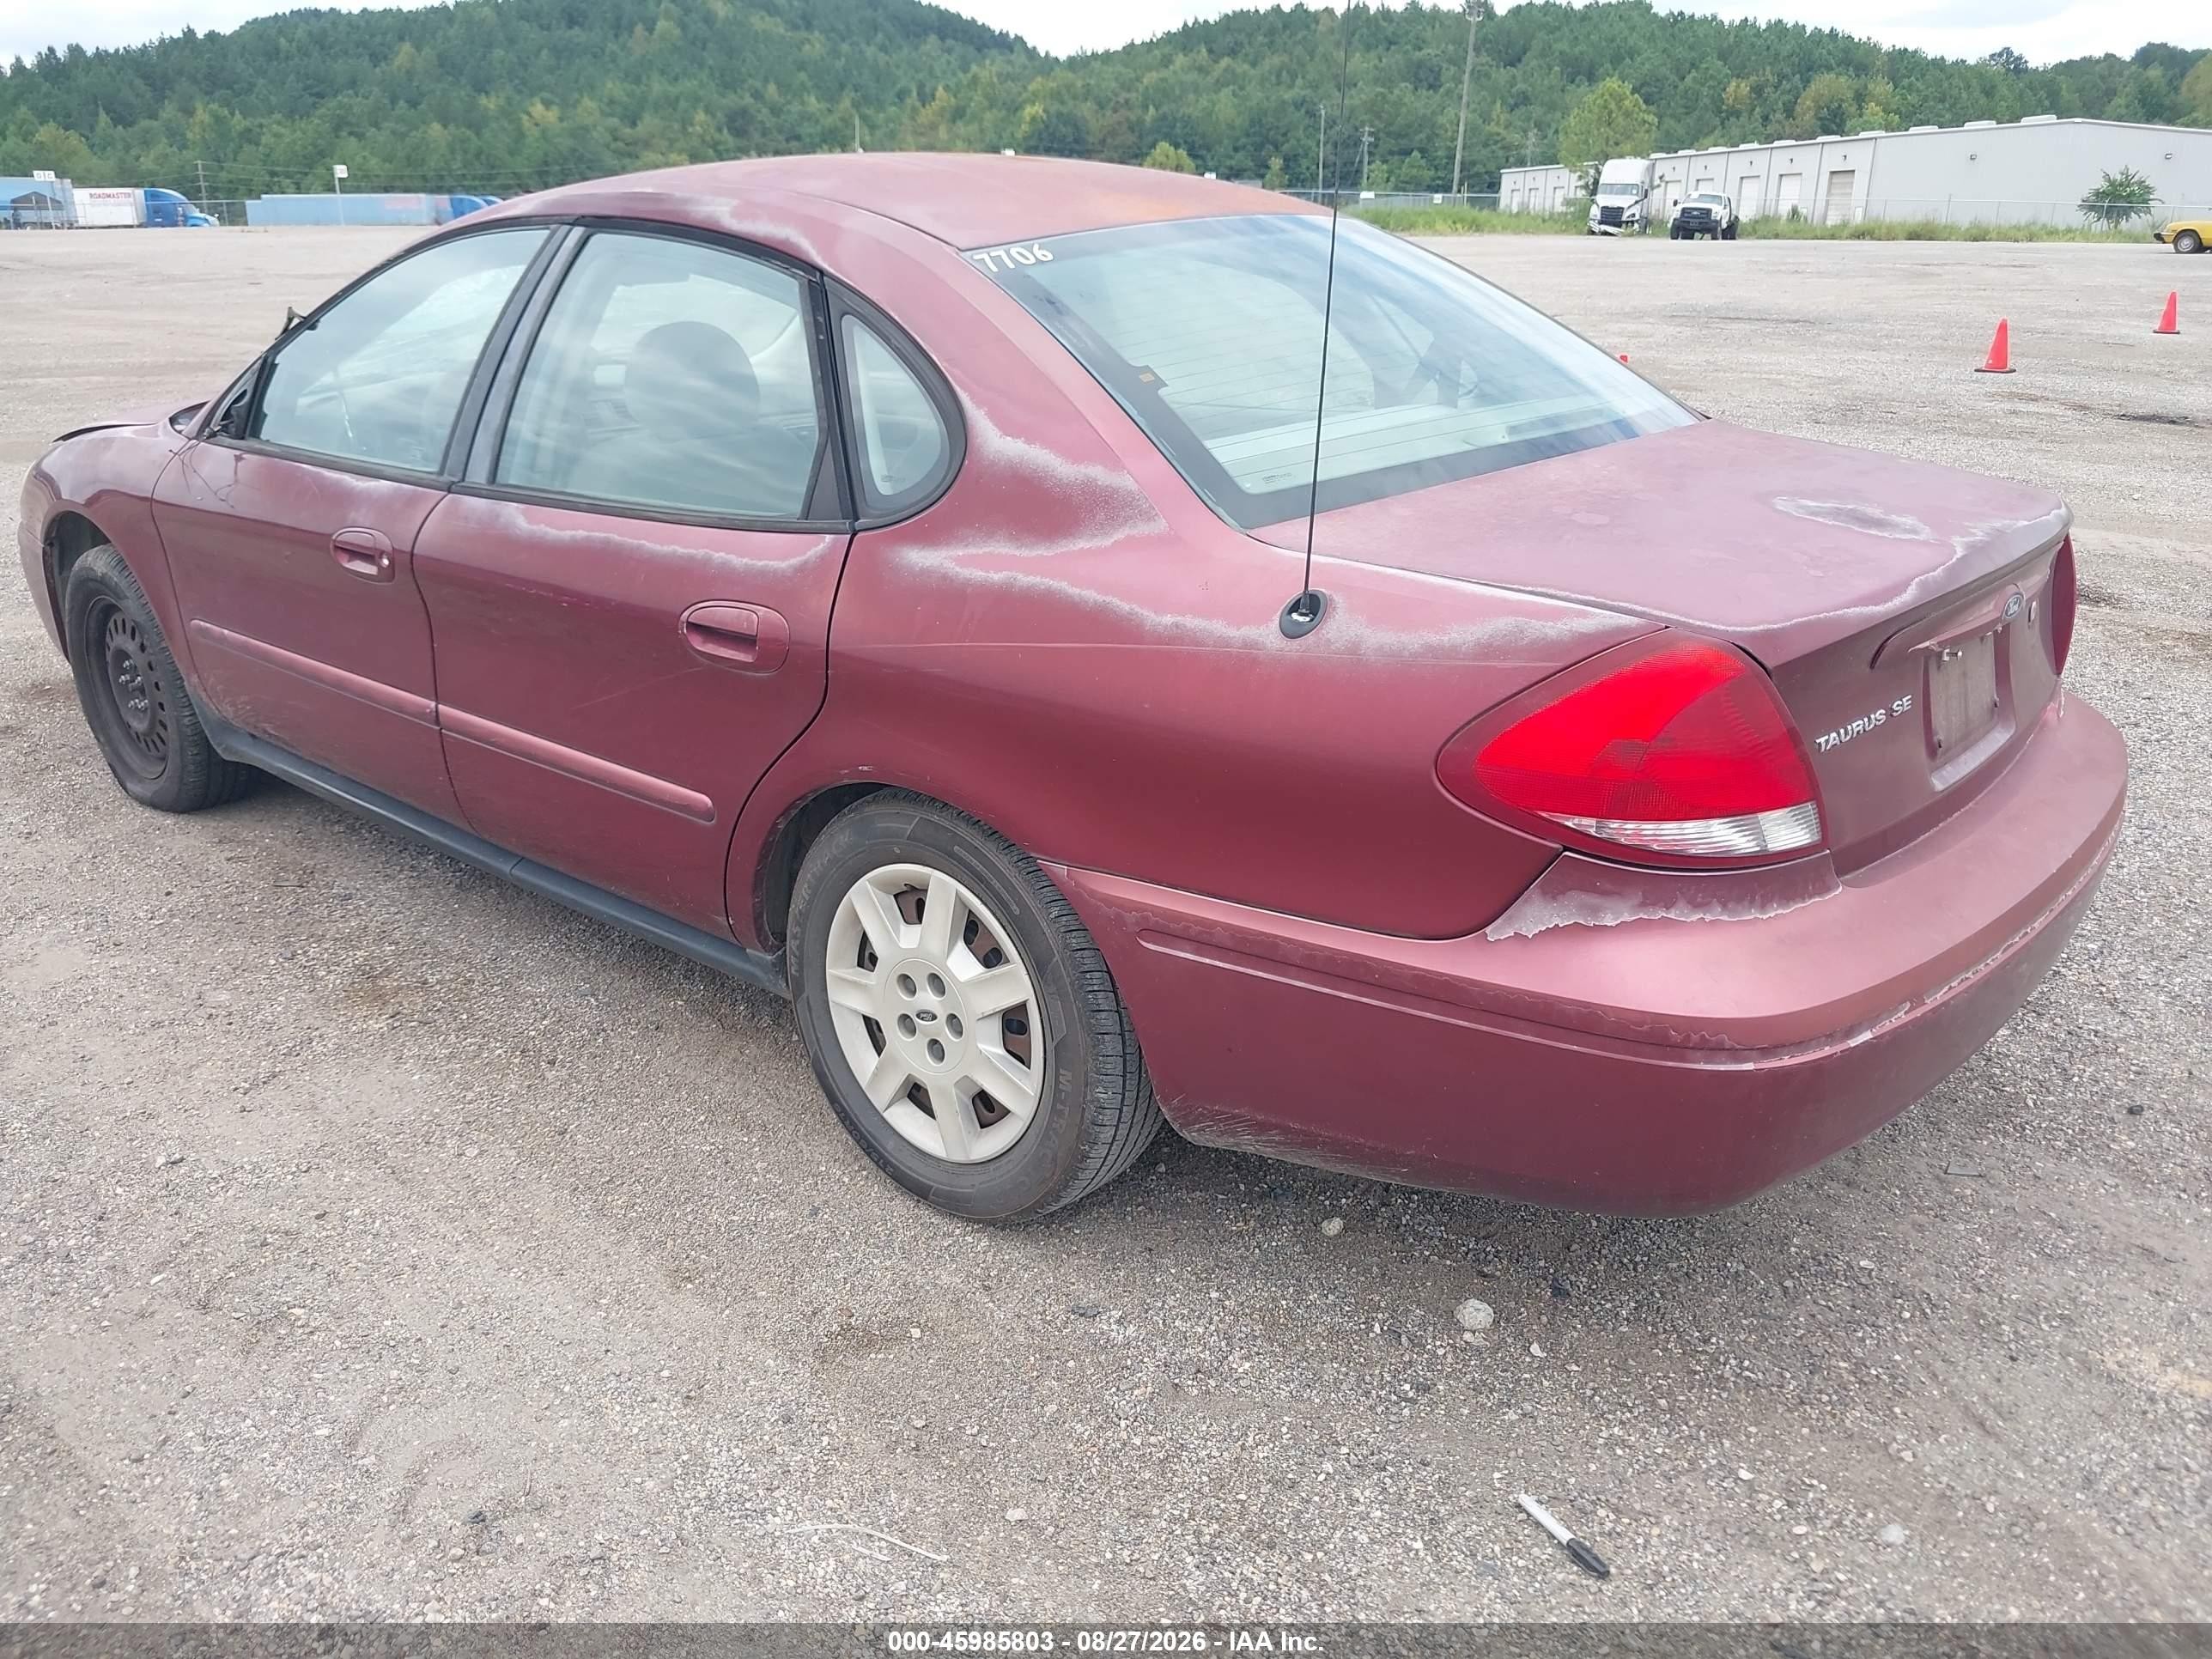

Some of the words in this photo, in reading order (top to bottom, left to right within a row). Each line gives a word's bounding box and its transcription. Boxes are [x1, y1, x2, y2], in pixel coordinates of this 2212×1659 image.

[972, 243, 1054, 272] 7706
[1814, 708, 1887, 752] TAURUS
[1890, 695, 1912, 717] SE
